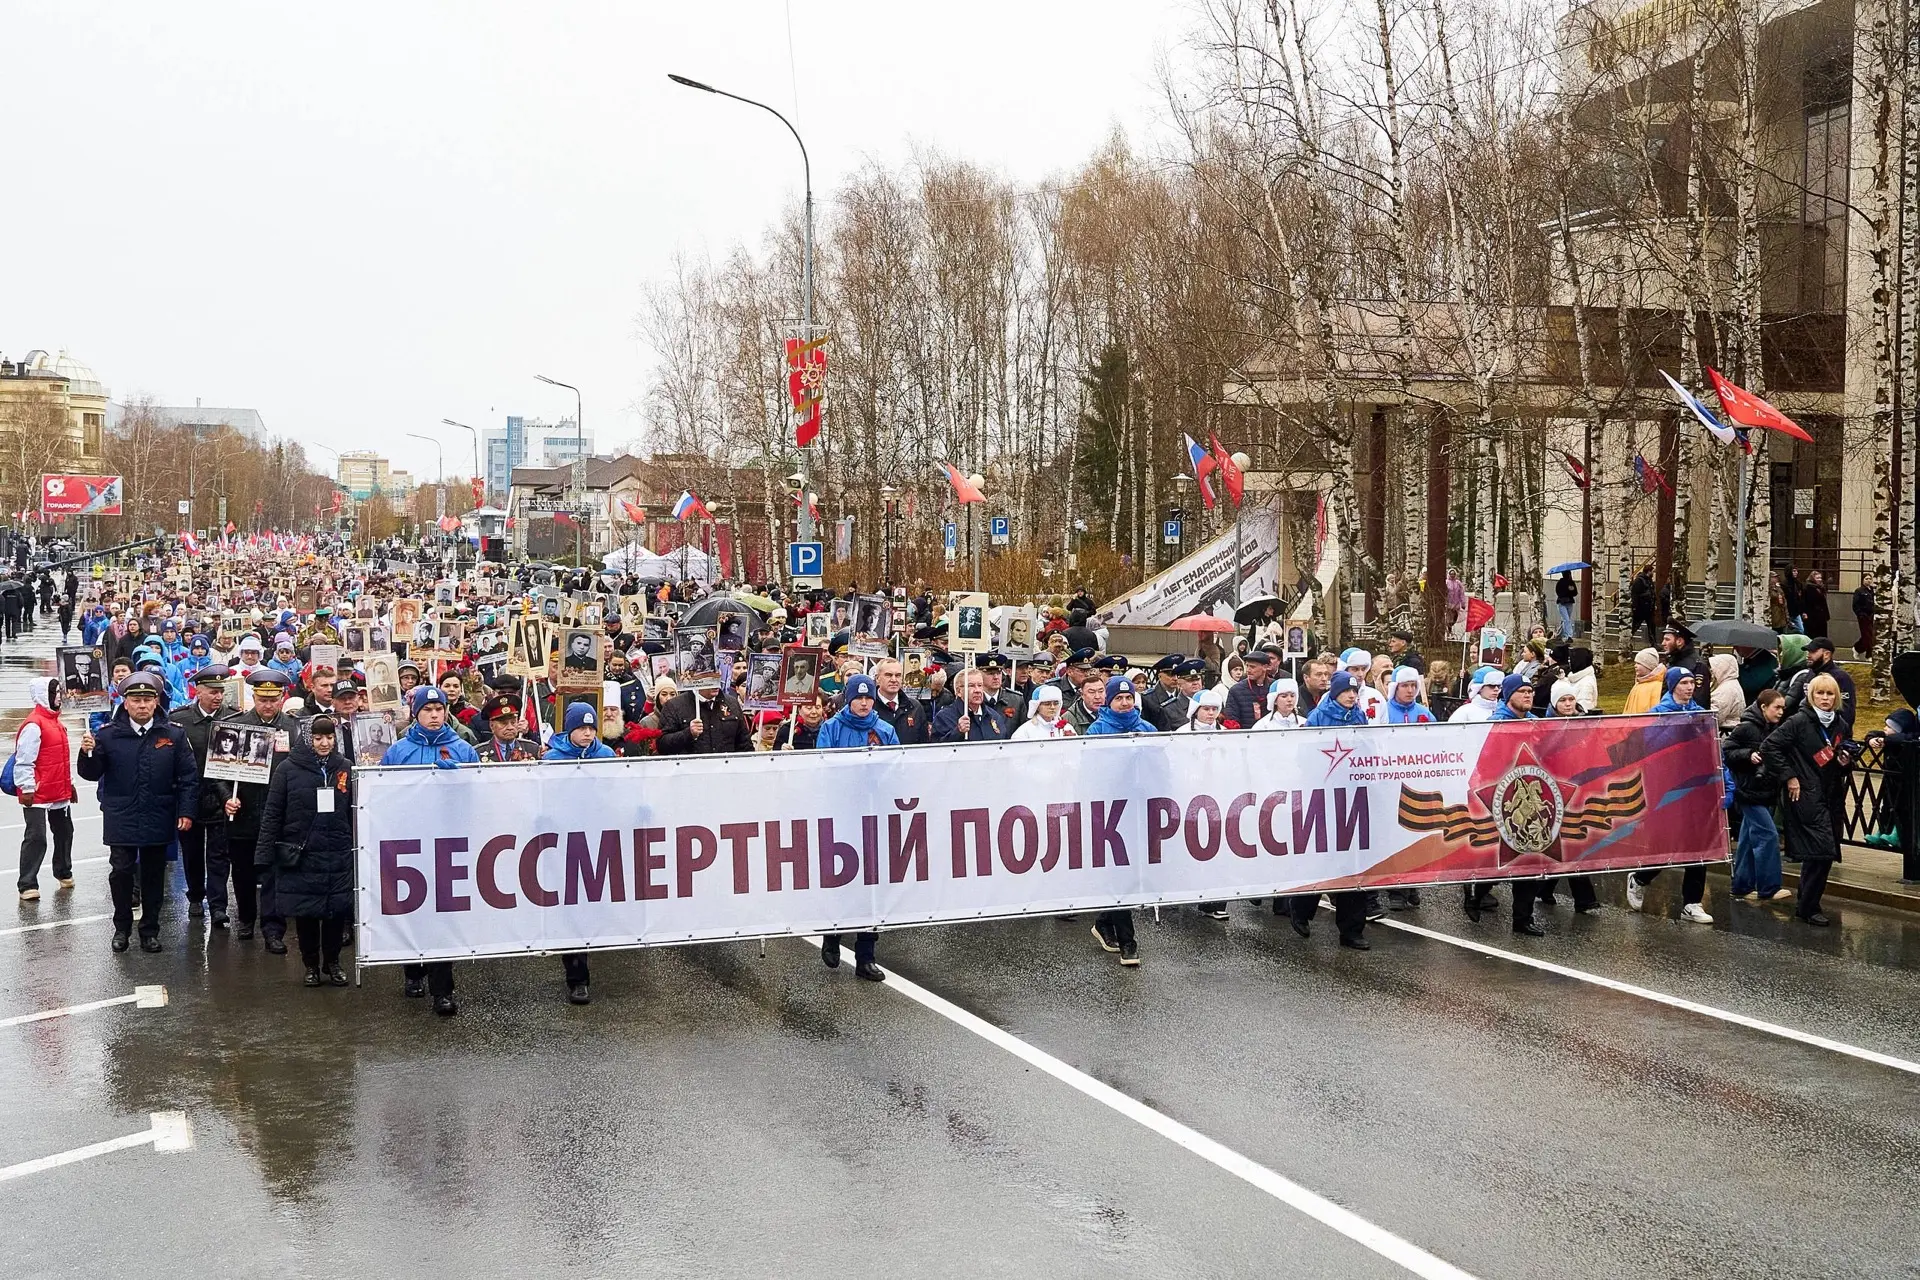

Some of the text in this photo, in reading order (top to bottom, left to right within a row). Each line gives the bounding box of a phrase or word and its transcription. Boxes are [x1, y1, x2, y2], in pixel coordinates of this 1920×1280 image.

[47, 479, 65, 497] 9
[996, 519, 1006, 533] P
[1167, 523, 1176, 535] P
[948, 526, 955, 545] P
[798, 547, 817, 572] P
[337, 681, 352, 690] UGRA
[1348, 751, 1464, 768] ХАНТЫ-МАНСИЙСК
[1349, 769, 1466, 781] ГОРОД ТРУДОВОЙ ДОБЛЕСТИ
[1530, 767, 1551, 782] ПОЛК
[1549, 781, 1563, 823] РОССИИ
[379, 786, 1371, 915] БЕССМЕРТНЫЙ ПОЛК РОССИИ
